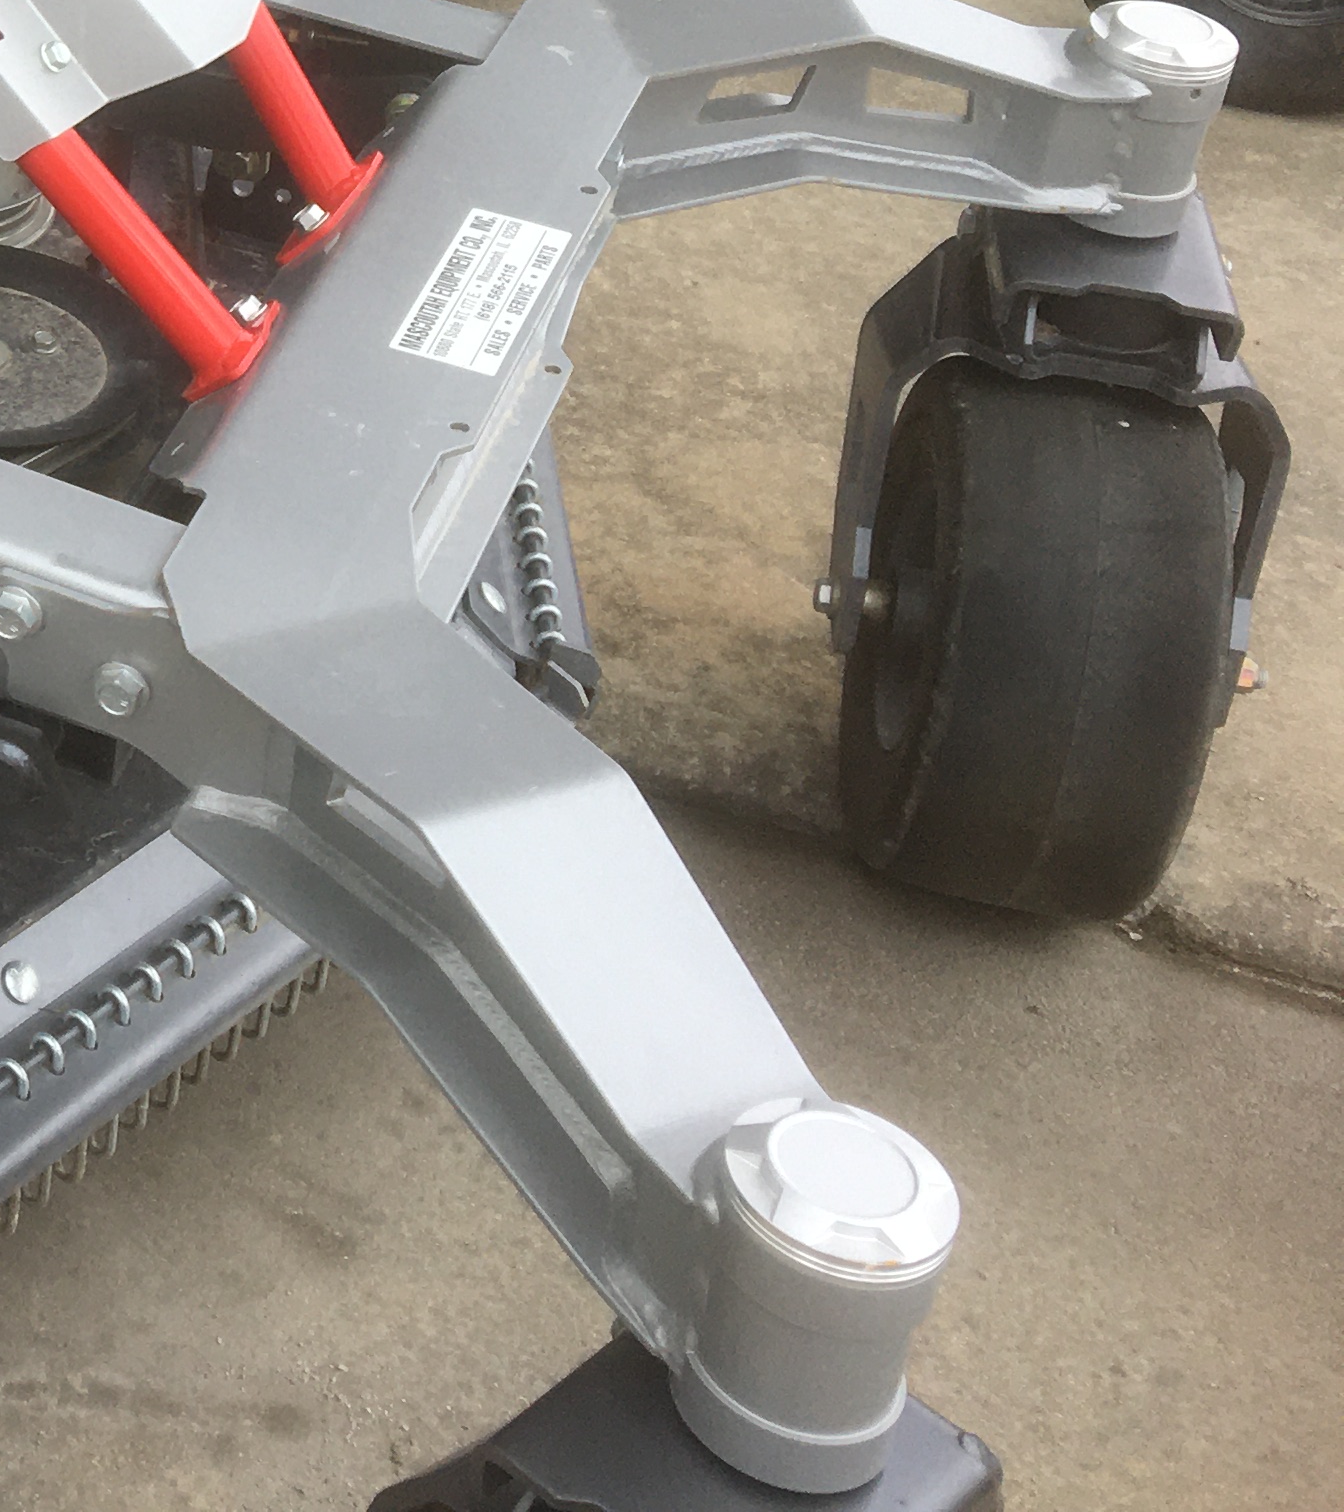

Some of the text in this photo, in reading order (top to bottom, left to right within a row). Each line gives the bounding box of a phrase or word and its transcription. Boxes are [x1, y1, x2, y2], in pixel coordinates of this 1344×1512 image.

[398, 295, 450, 352] MASCOUTAH
[430, 247, 477, 298] EQUIPMENT
[484, 245, 558, 356] SALES SERVICE PARTS
